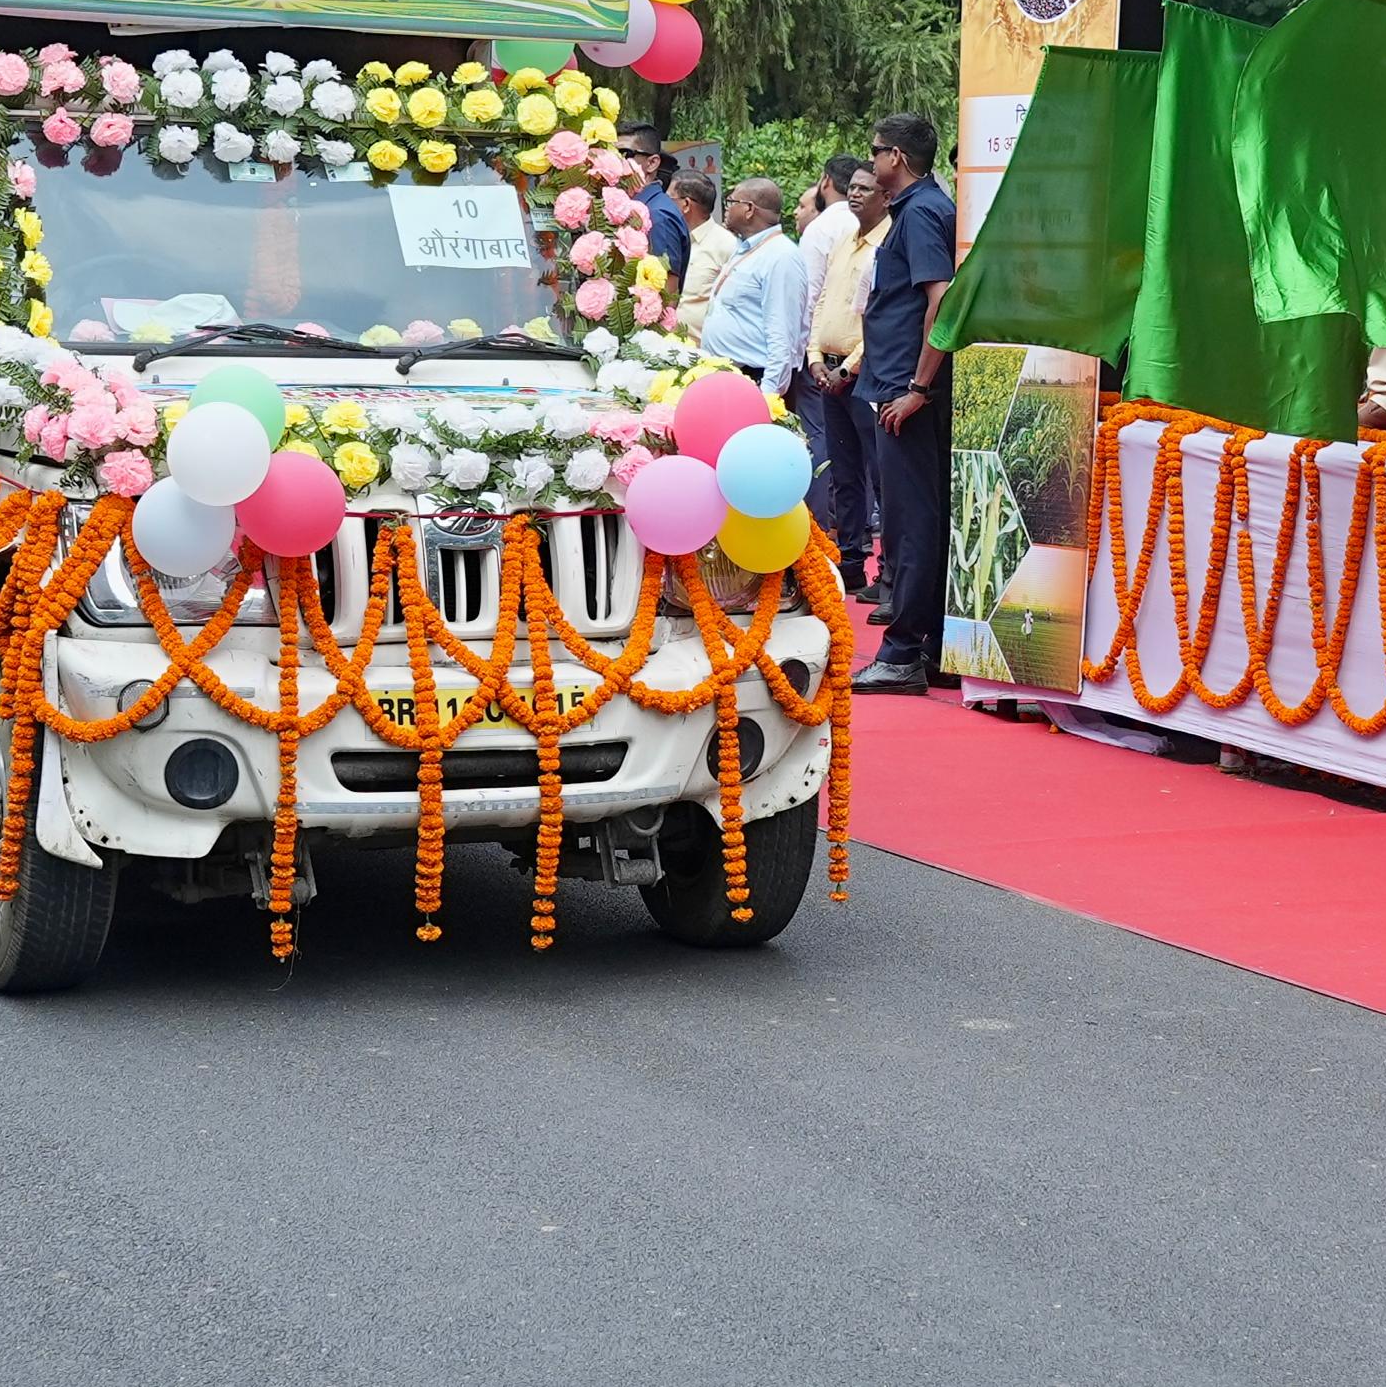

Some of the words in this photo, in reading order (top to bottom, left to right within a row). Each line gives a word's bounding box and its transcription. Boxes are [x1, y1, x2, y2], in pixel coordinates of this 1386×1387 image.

[988, 137, 1000, 154] 15
[451, 199, 479, 220] 10
[417, 228, 528, 261] औरंगाबाद
